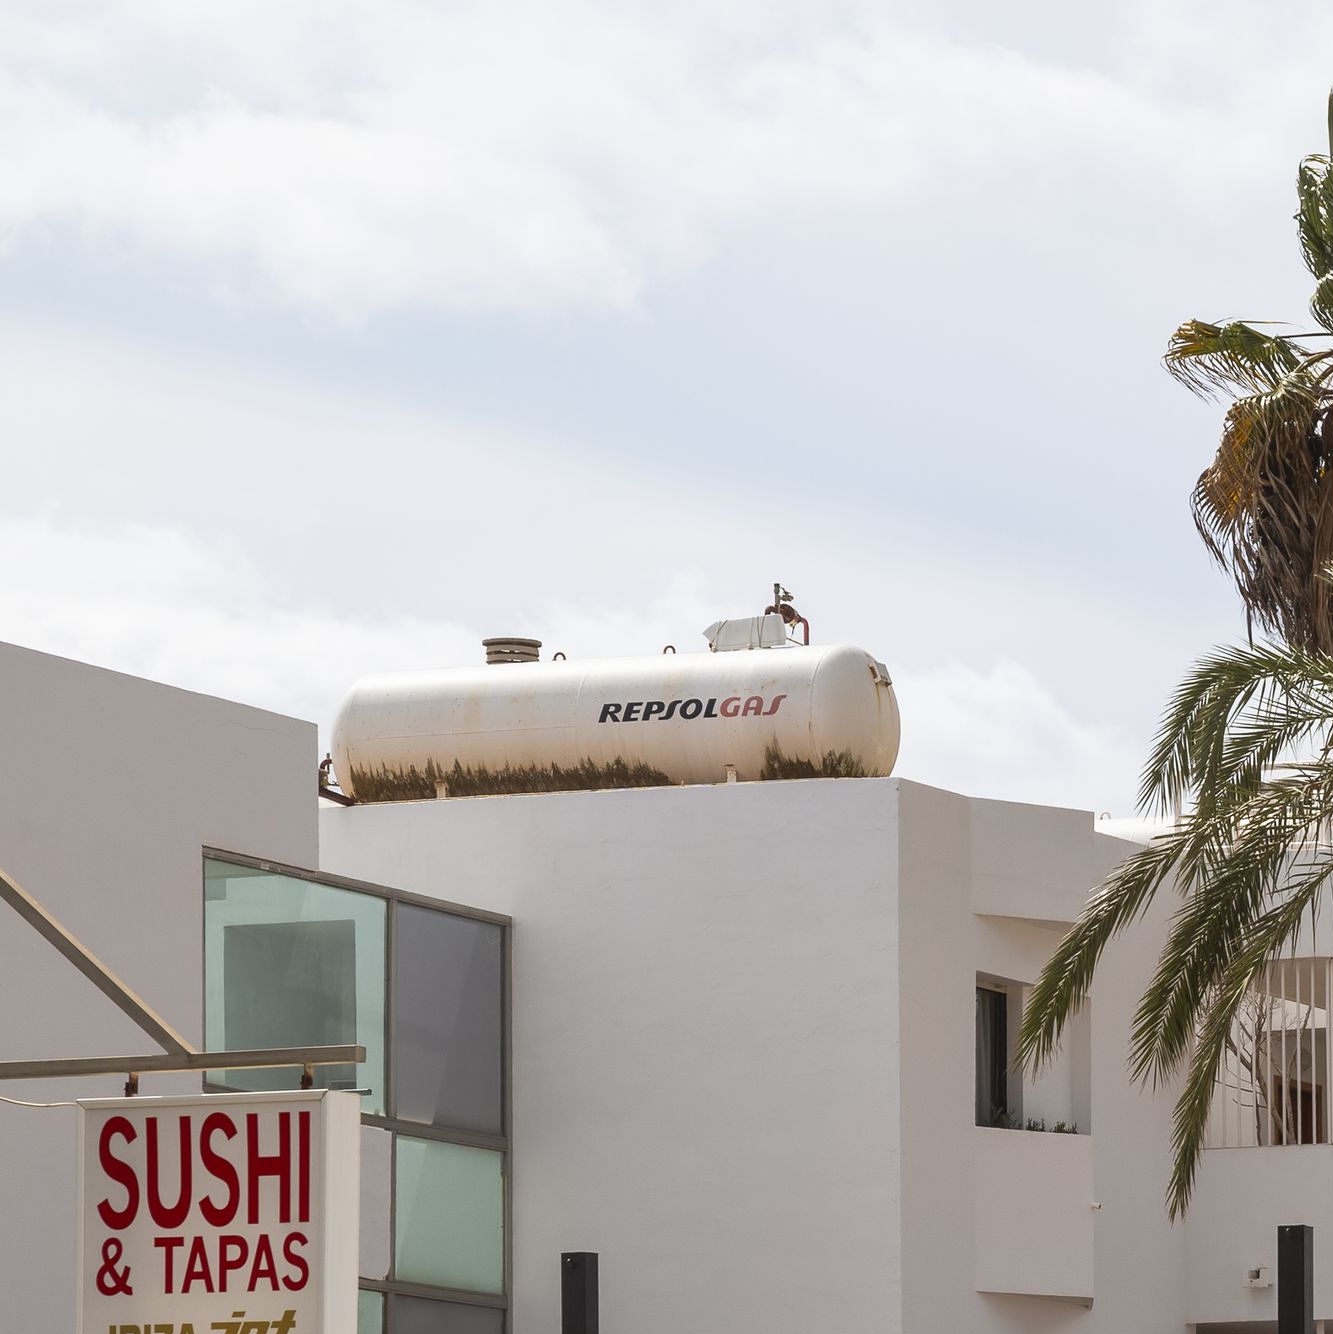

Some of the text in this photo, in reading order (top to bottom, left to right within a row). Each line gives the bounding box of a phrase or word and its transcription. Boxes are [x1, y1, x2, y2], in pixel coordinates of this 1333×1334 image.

[599, 694, 788, 723] REPSOLGAS
[97, 1111, 311, 1230] SUSHI
[96, 1231, 310, 1296] & TAPAS
